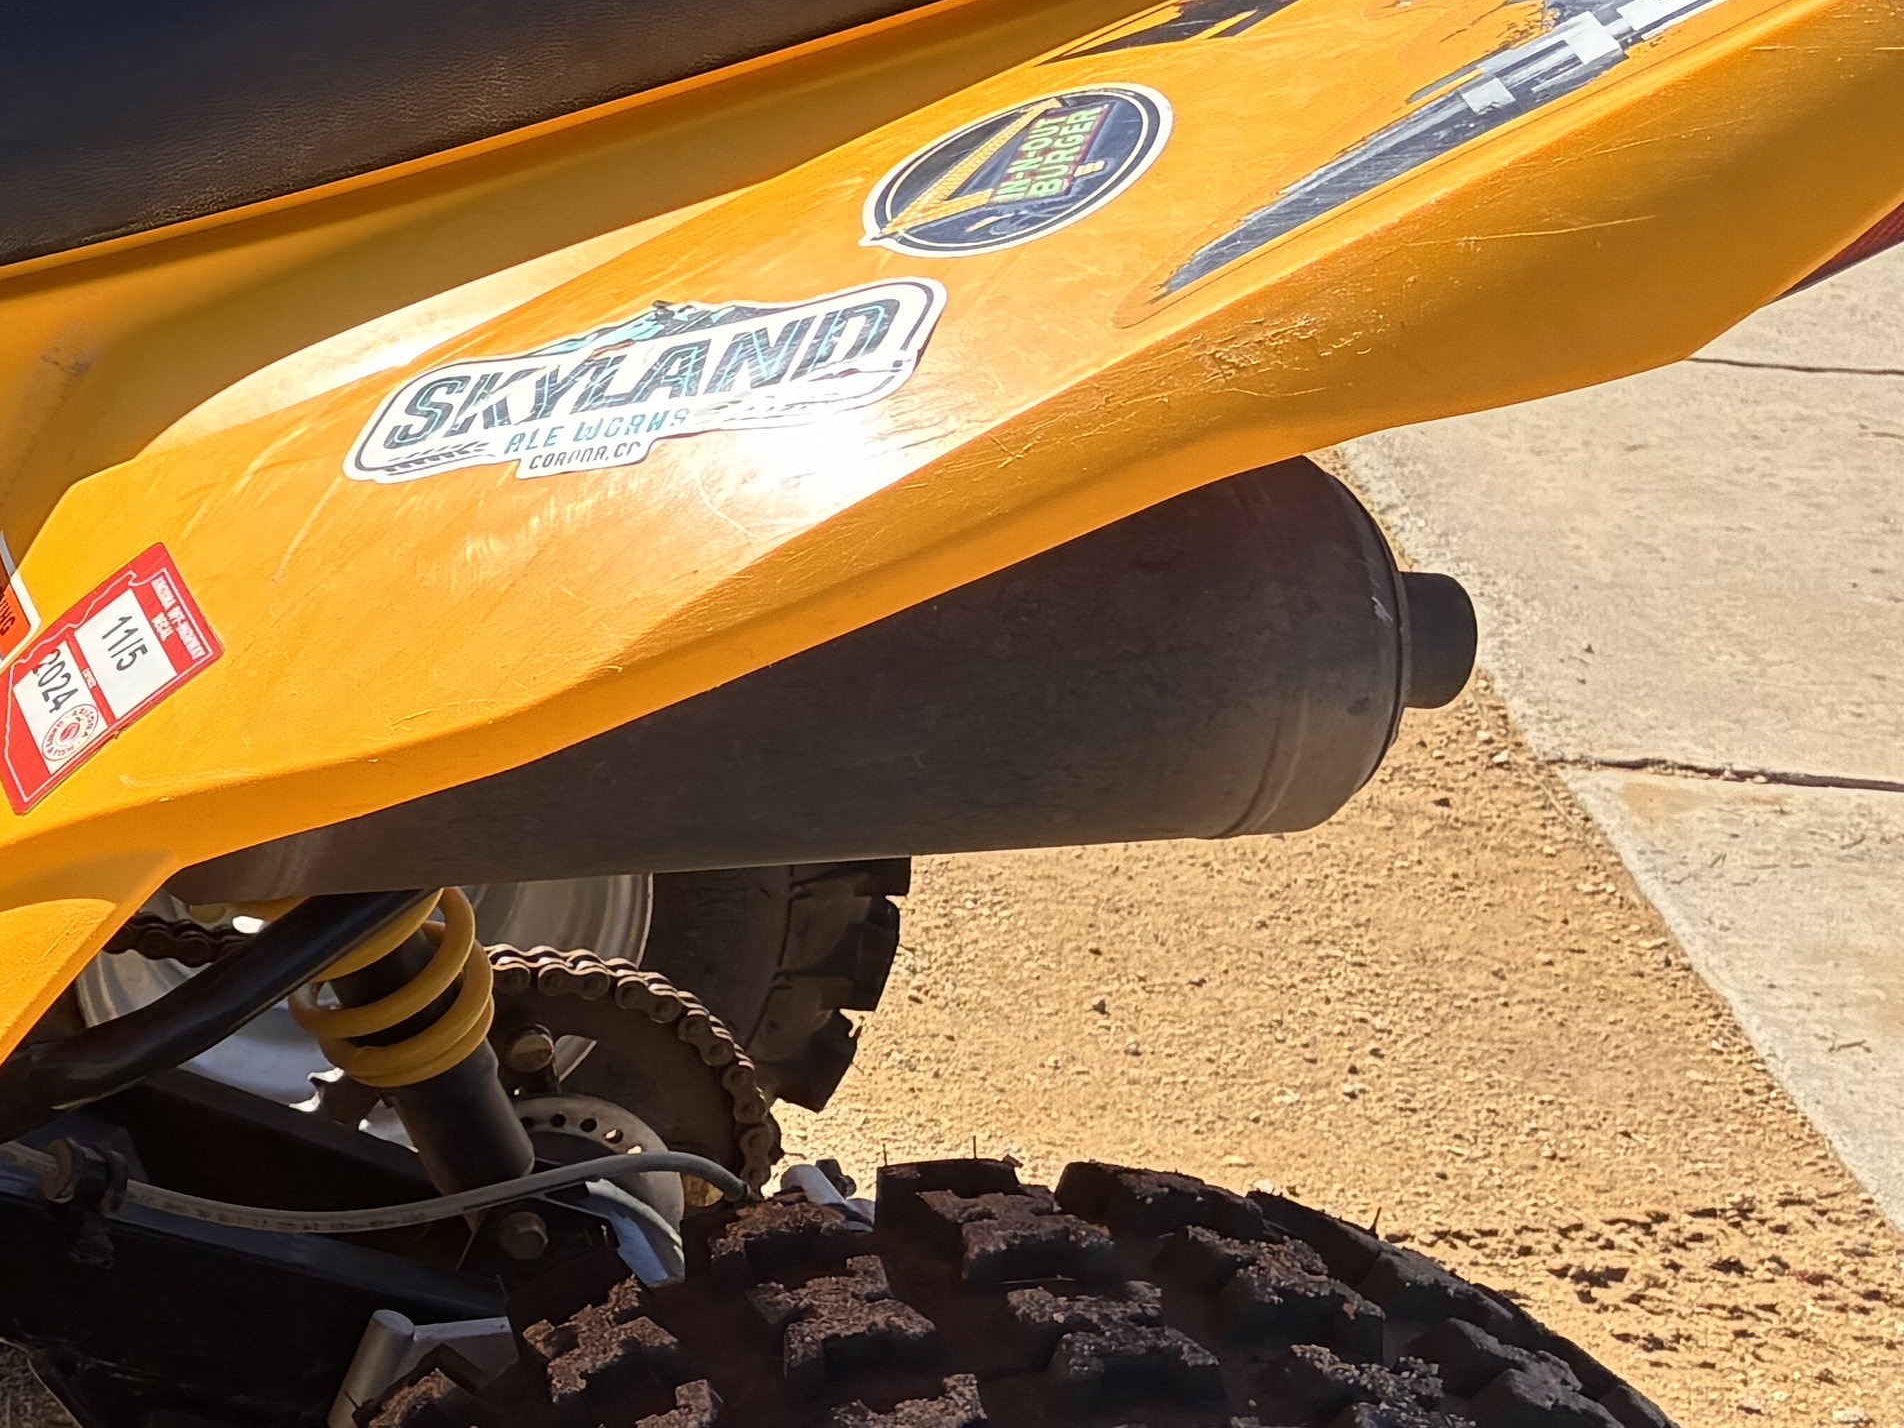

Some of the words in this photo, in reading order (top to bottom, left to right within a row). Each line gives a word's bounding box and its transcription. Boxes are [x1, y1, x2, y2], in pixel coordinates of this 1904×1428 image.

[992, 115, 1068, 204] IN-N-OUT
[1028, 106, 1104, 199] BURGER
[383, 299, 901, 451] SKYLAND
[32, 648, 79, 714] 2024
[101, 615, 149, 671] 11/5
